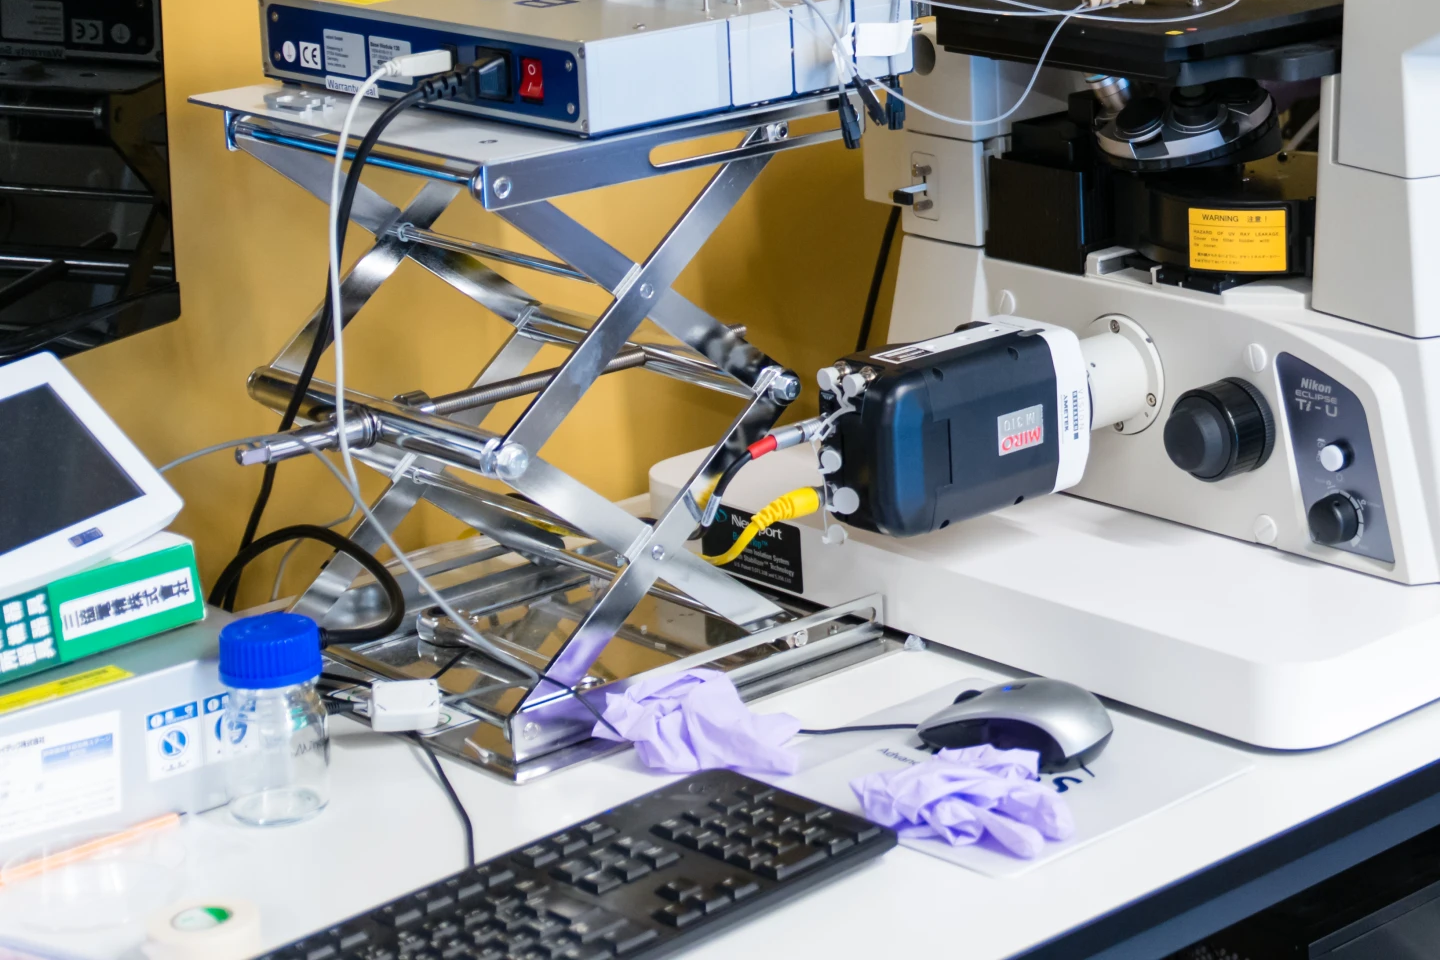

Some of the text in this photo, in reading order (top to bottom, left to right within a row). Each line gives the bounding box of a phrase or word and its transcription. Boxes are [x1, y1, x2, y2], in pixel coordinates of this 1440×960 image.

[327, 79, 359, 93] Warranty
[1202, 214, 1239, 222] WARNING
[1300, 377, 1332, 394] Nikon
[1295, 389, 1338, 405] ECLIPSE
[1003, 416, 1024, 432] 310
[1001, 425, 1042, 452] MIRO
[731, 513, 783, 540] Neport
